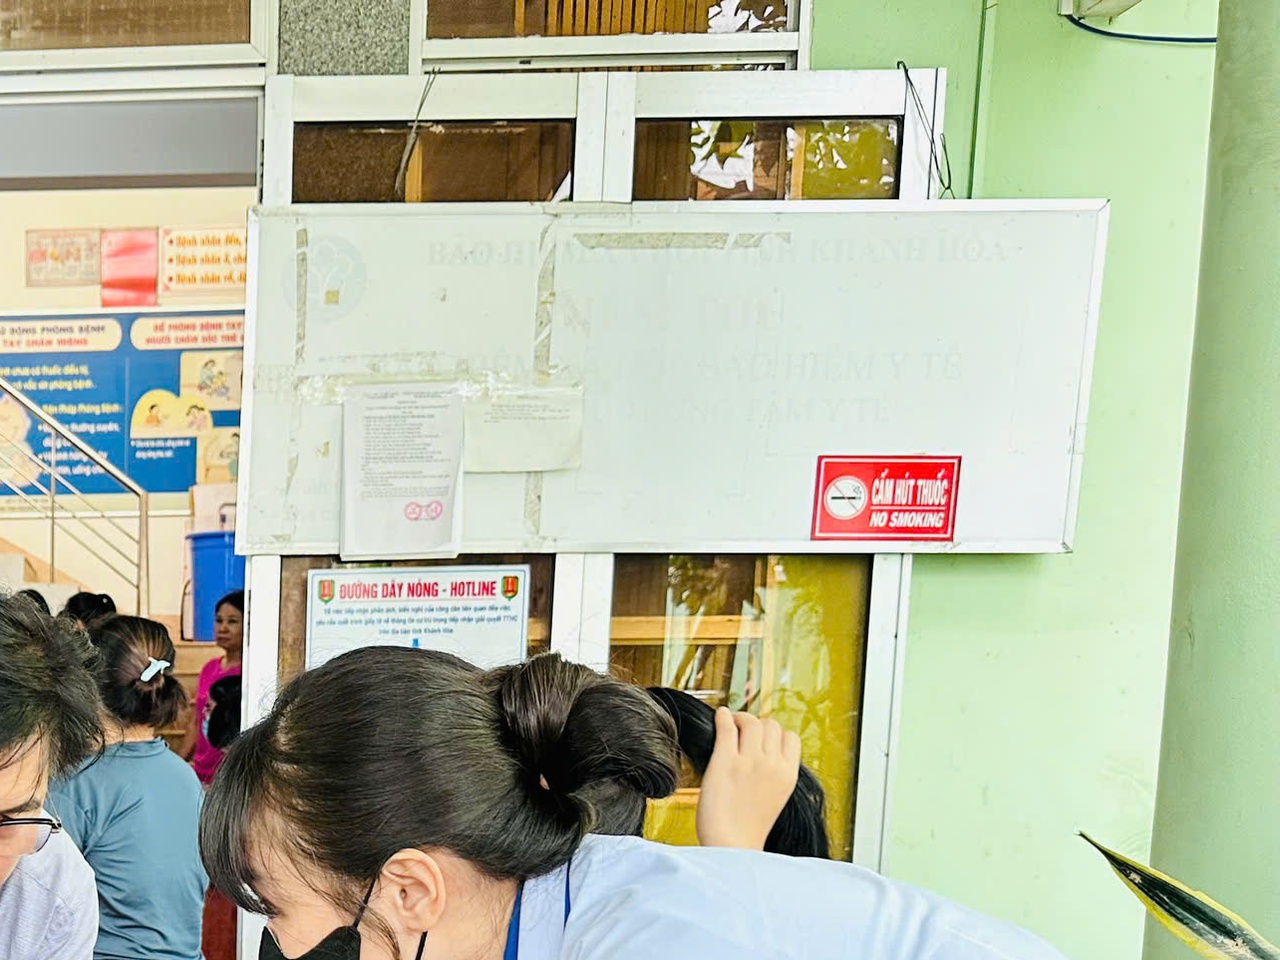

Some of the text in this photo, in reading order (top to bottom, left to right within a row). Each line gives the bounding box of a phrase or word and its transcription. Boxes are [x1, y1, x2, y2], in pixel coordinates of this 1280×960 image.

[872, 469, 948, 506] CẤM HÚT THUỐC
[869, 511, 945, 528] NO SMOKING
[339, 579, 378, 600] ĐƯỜNG
[381, 578, 403, 599] DÂY
[407, 577, 439, 598] NÓNG
[450, 580, 497, 598] HOTLINE
